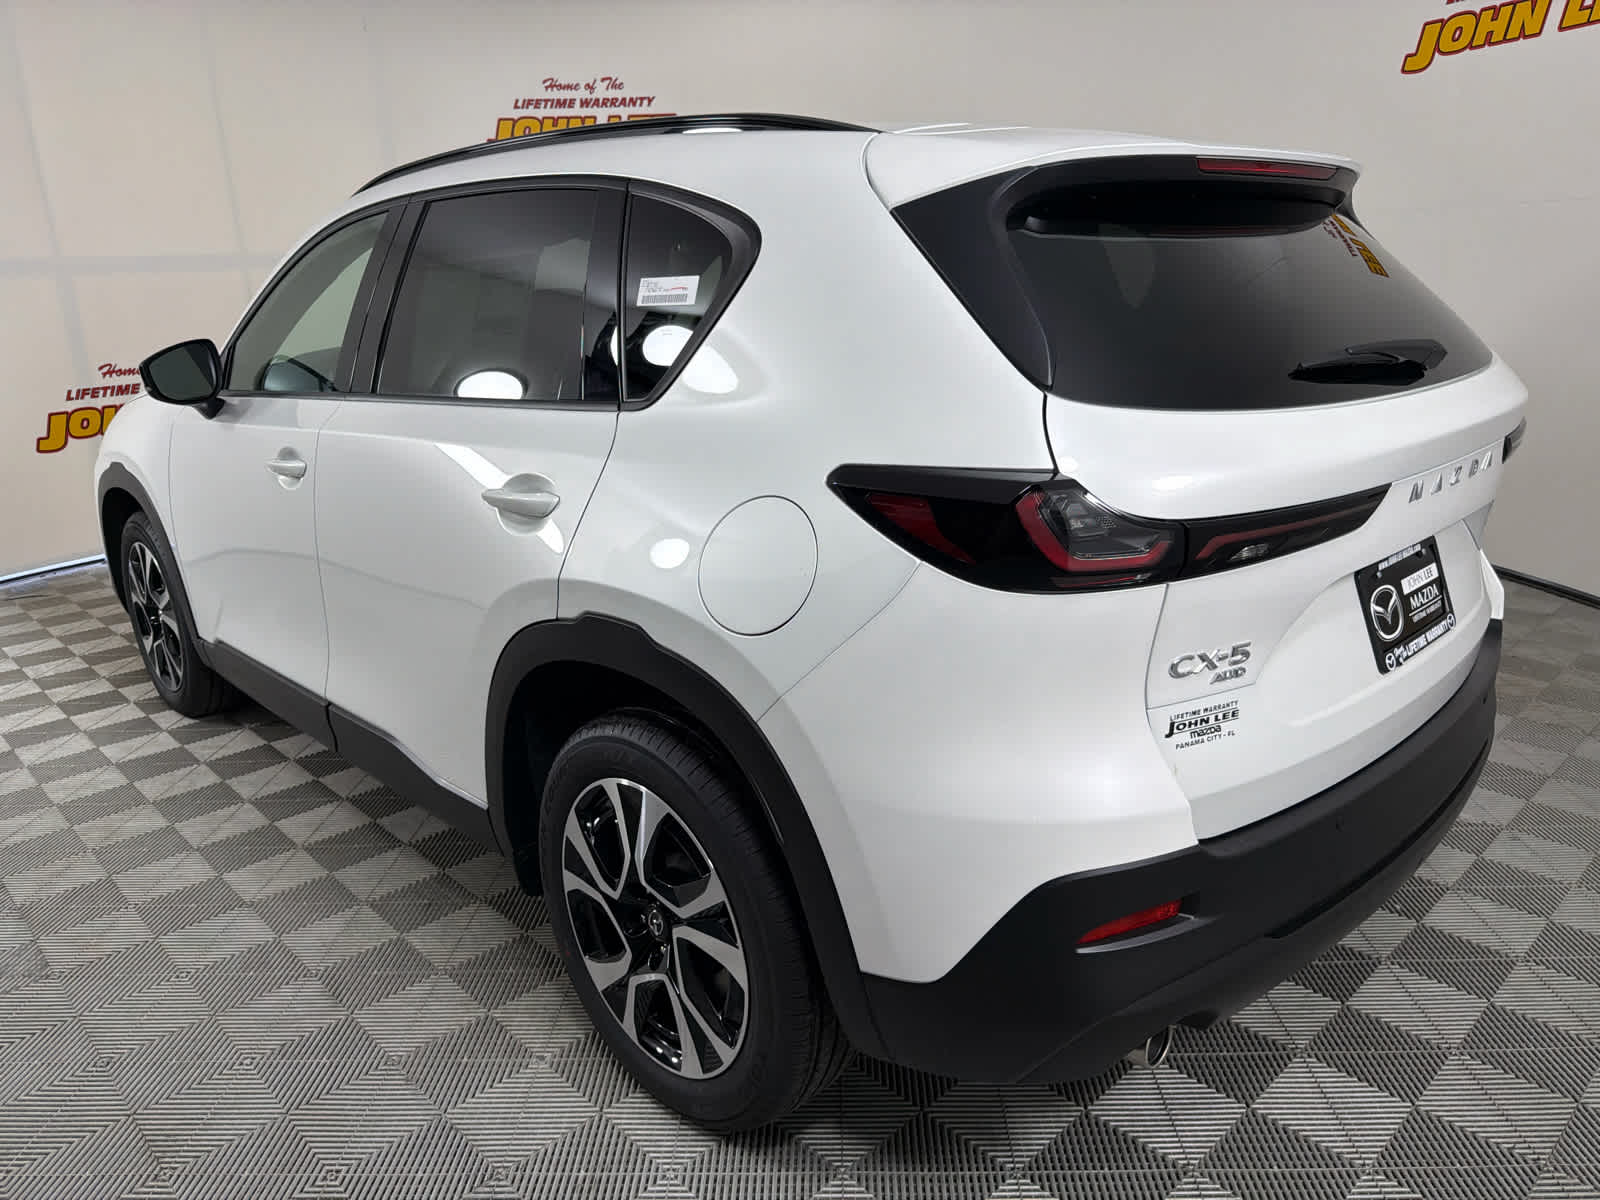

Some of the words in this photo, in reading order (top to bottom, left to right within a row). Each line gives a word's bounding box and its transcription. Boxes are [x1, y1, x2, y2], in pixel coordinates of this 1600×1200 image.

[1401, 0, 1552, 74] JOHN
[1558, 0, 1600, 32] L
[542, 77, 580, 92] Home
[584, 79, 597, 94] of
[601, 77, 625, 91] The
[513, 98, 576, 110] LIFETIME
[579, 96, 656, 109] WARRANTY
[65, 383, 141, 401] LIFETIME
[36, 403, 125, 454] JO
[1408, 451, 1493, 504] MAZDA
[1406, 574, 1424, 590] JOHN
[1424, 566, 1434, 581] LEE
[1409, 585, 1440, 611] MAZDA
[1168, 640, 1252, 679] CX-5
[1209, 667, 1247, 685] AWD
[1169, 709, 1201, 722] LIFETIME
[1203, 700, 1239, 714] WARRANTY
[1165, 717, 1210, 739] JOHN
[1214, 709, 1240, 722] LEE
[1175, 738, 1205, 750] PANAMA
[1206, 734, 1222, 743] CITY
